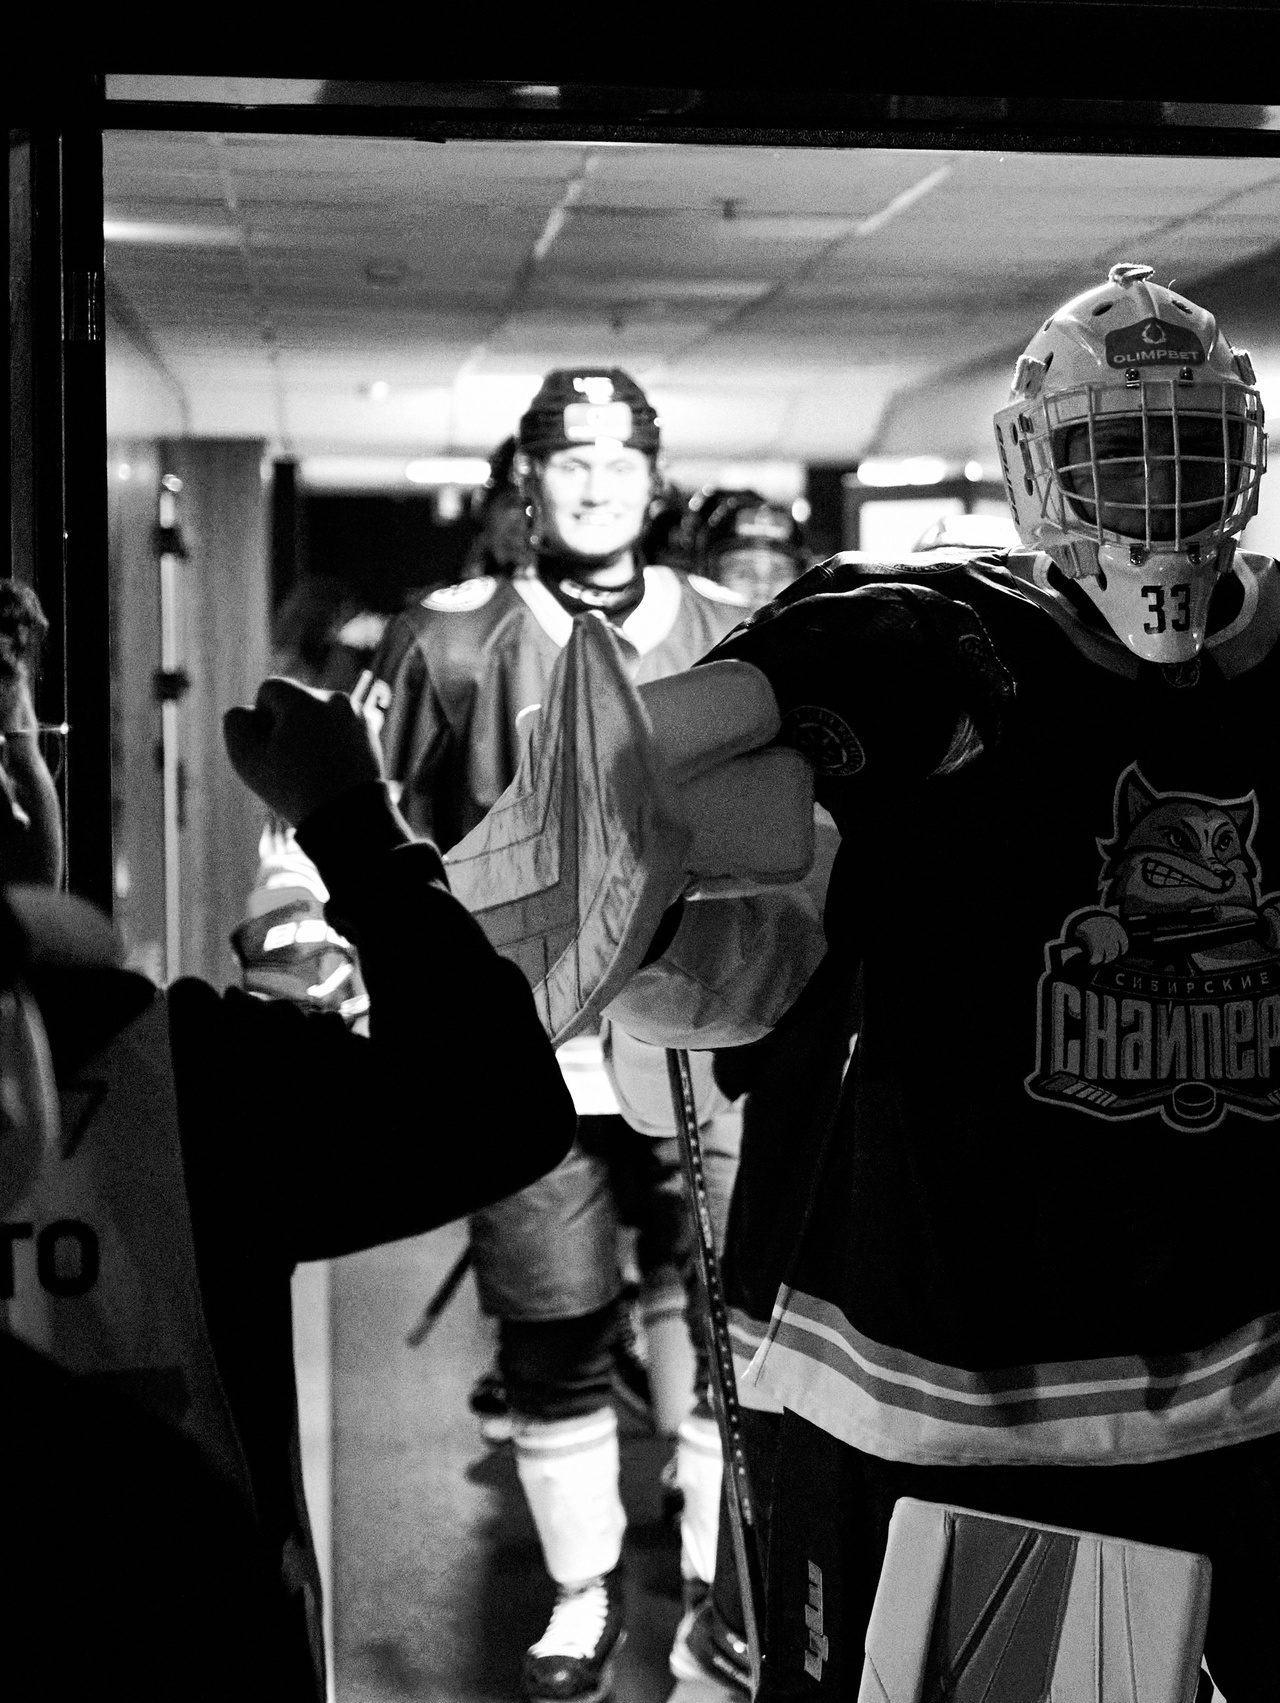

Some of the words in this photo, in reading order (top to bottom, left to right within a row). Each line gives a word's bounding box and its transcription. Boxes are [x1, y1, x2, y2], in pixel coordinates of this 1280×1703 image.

[1113, 350, 1199, 364] OLIMPBET
[1141, 583, 1191, 635] 33
[1114, 971, 1270, 994] СИБИРСКИЕ
